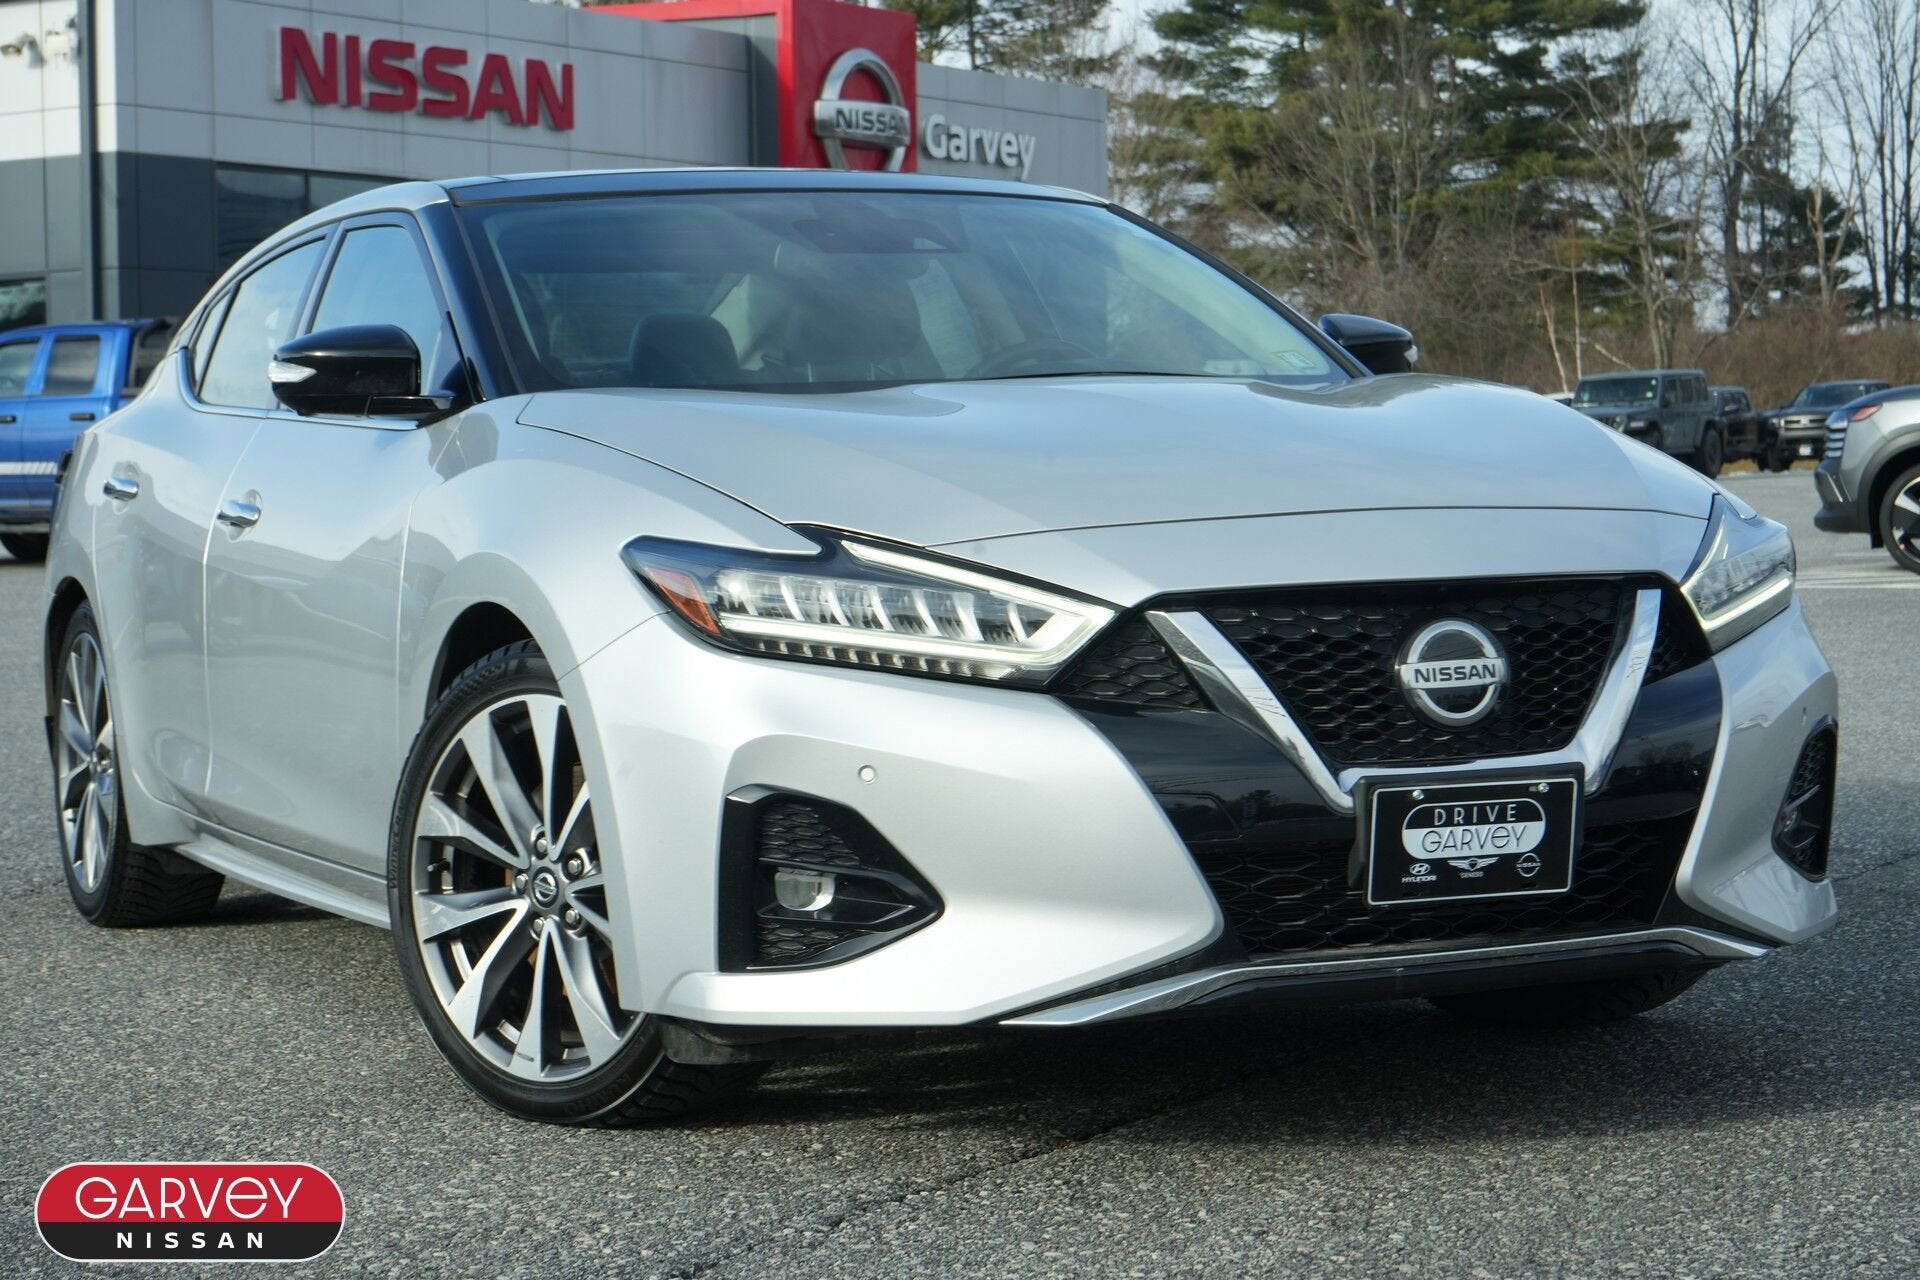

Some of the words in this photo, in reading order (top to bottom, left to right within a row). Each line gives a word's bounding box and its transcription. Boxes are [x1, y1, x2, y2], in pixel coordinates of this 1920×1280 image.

[280, 27, 575, 130] NISSAN
[834, 107, 909, 137] NISSAN
[924, 113, 1037, 182] Garvey
[1414, 663, 1497, 684] NISSAN
[1433, 803, 1518, 826] DRIVE
